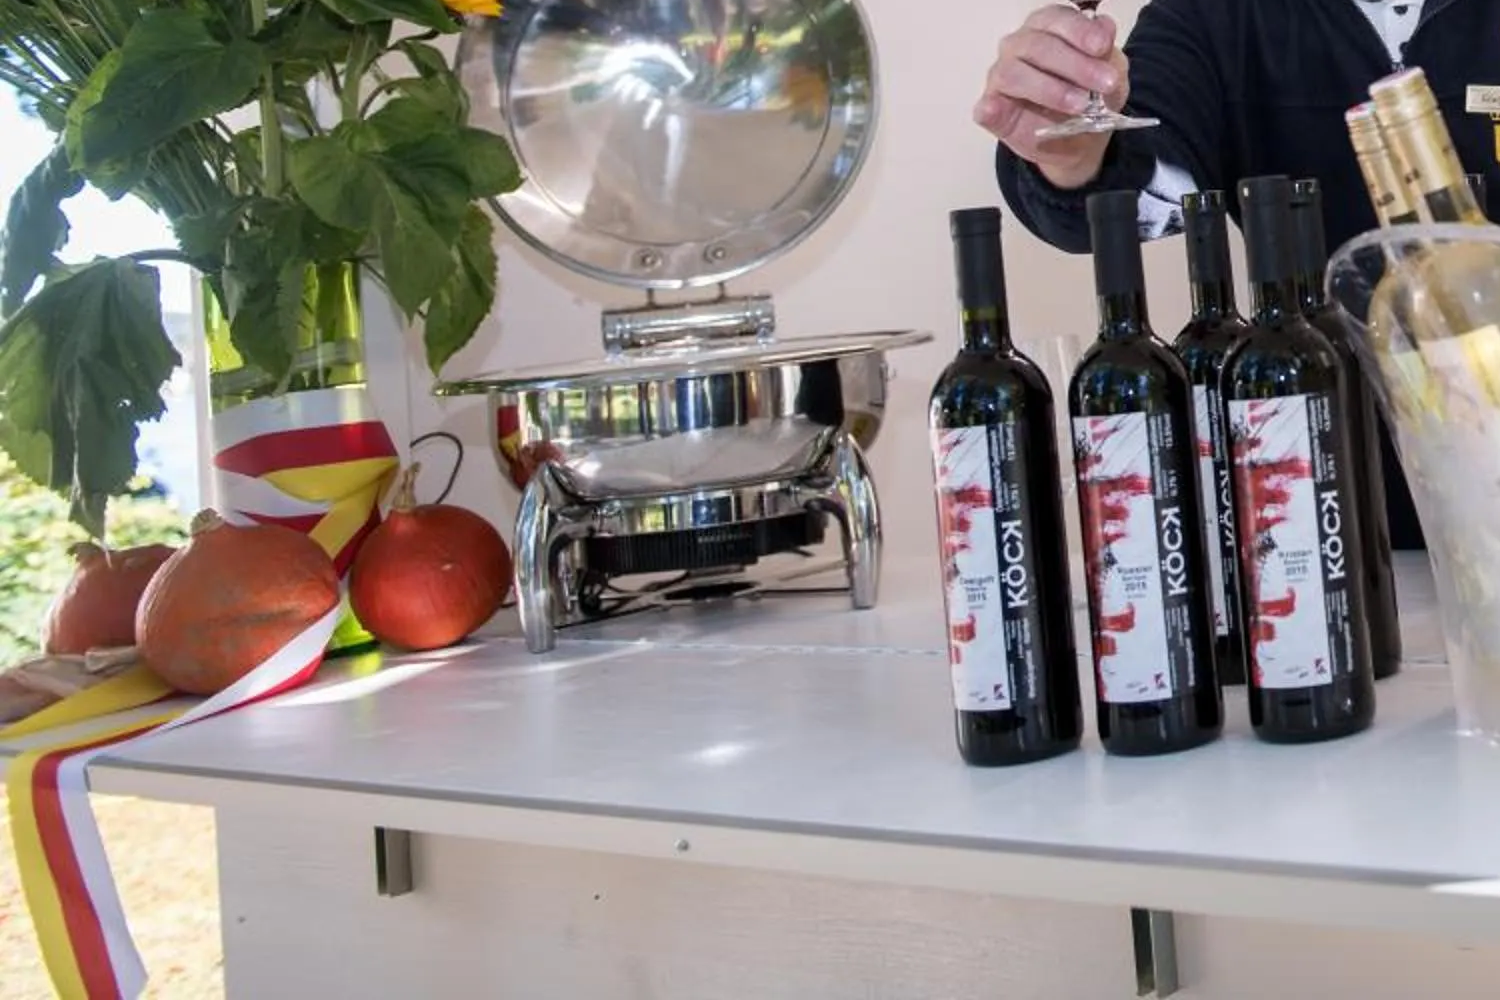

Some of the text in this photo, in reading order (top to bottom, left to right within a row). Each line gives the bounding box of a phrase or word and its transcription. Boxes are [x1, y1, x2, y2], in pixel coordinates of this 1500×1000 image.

[1001, 519, 1029, 609] KÖCK
[1161, 506, 1188, 596] KÖCK
[1320, 489, 1346, 580] KÖCK
